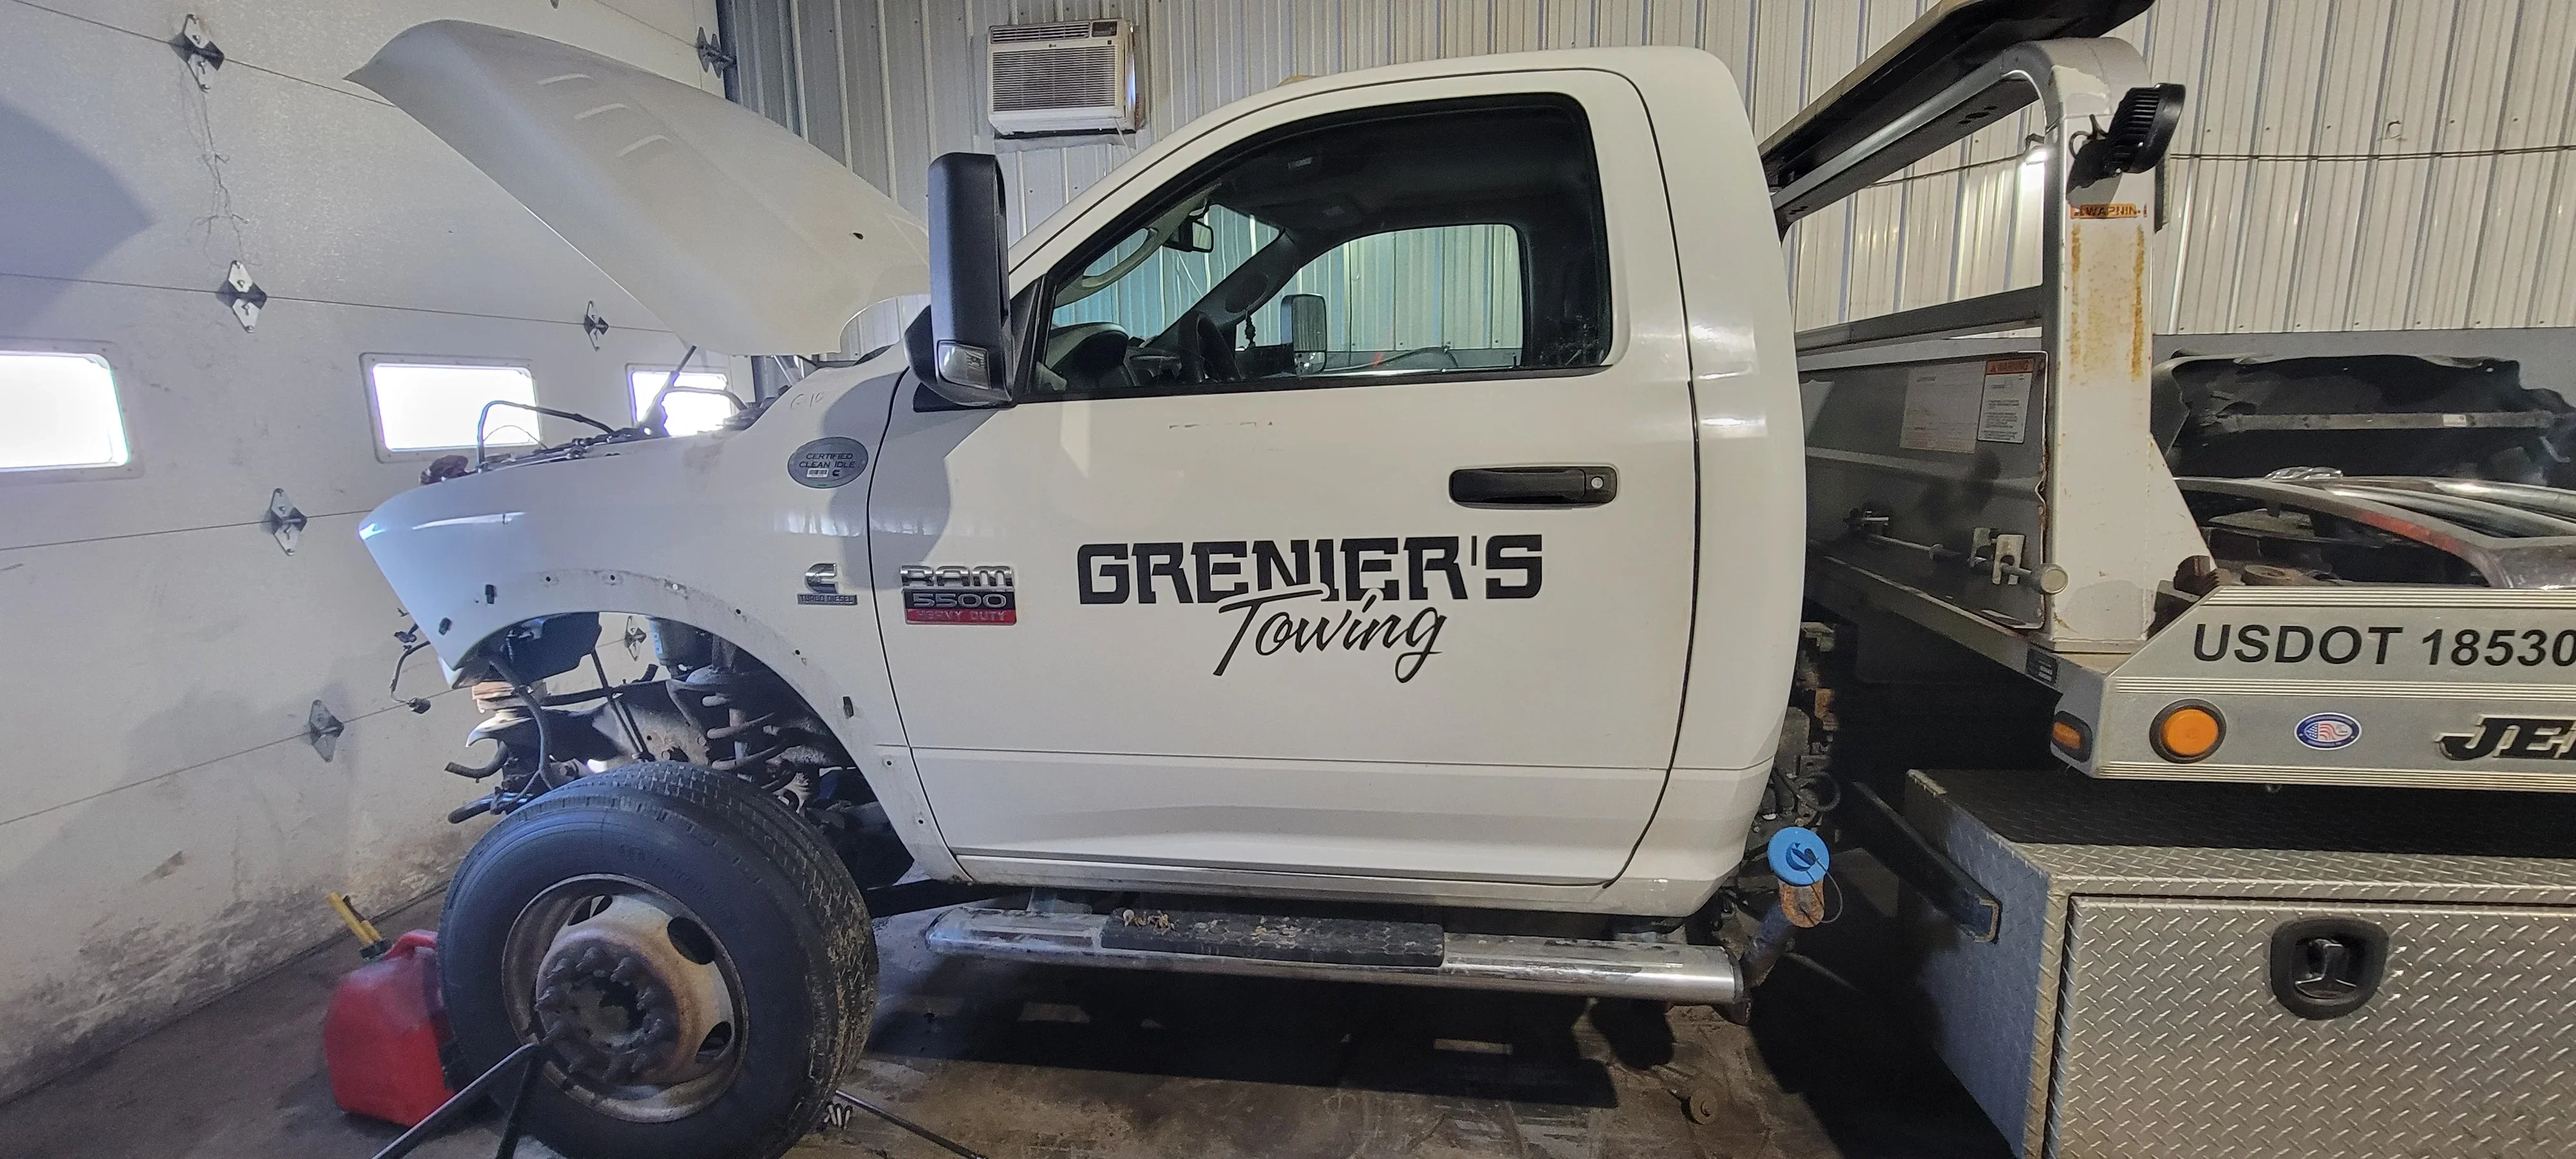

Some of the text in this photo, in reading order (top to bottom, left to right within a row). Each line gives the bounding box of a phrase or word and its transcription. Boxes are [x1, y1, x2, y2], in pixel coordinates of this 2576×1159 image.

[2086, 205, 2141, 216] WARNIN
[900, 565, 1014, 587] RAM
[1077, 534, 1543, 605] GRENIER'S
[827, 595, 854, 603] DIESEL
[912, 592, 1007, 608] 5500
[916, 610, 1006, 621] HEAVY DUTY
[1213, 589, 1448, 684] Towing
[2193, 623, 2576, 666] USDOT 18530
